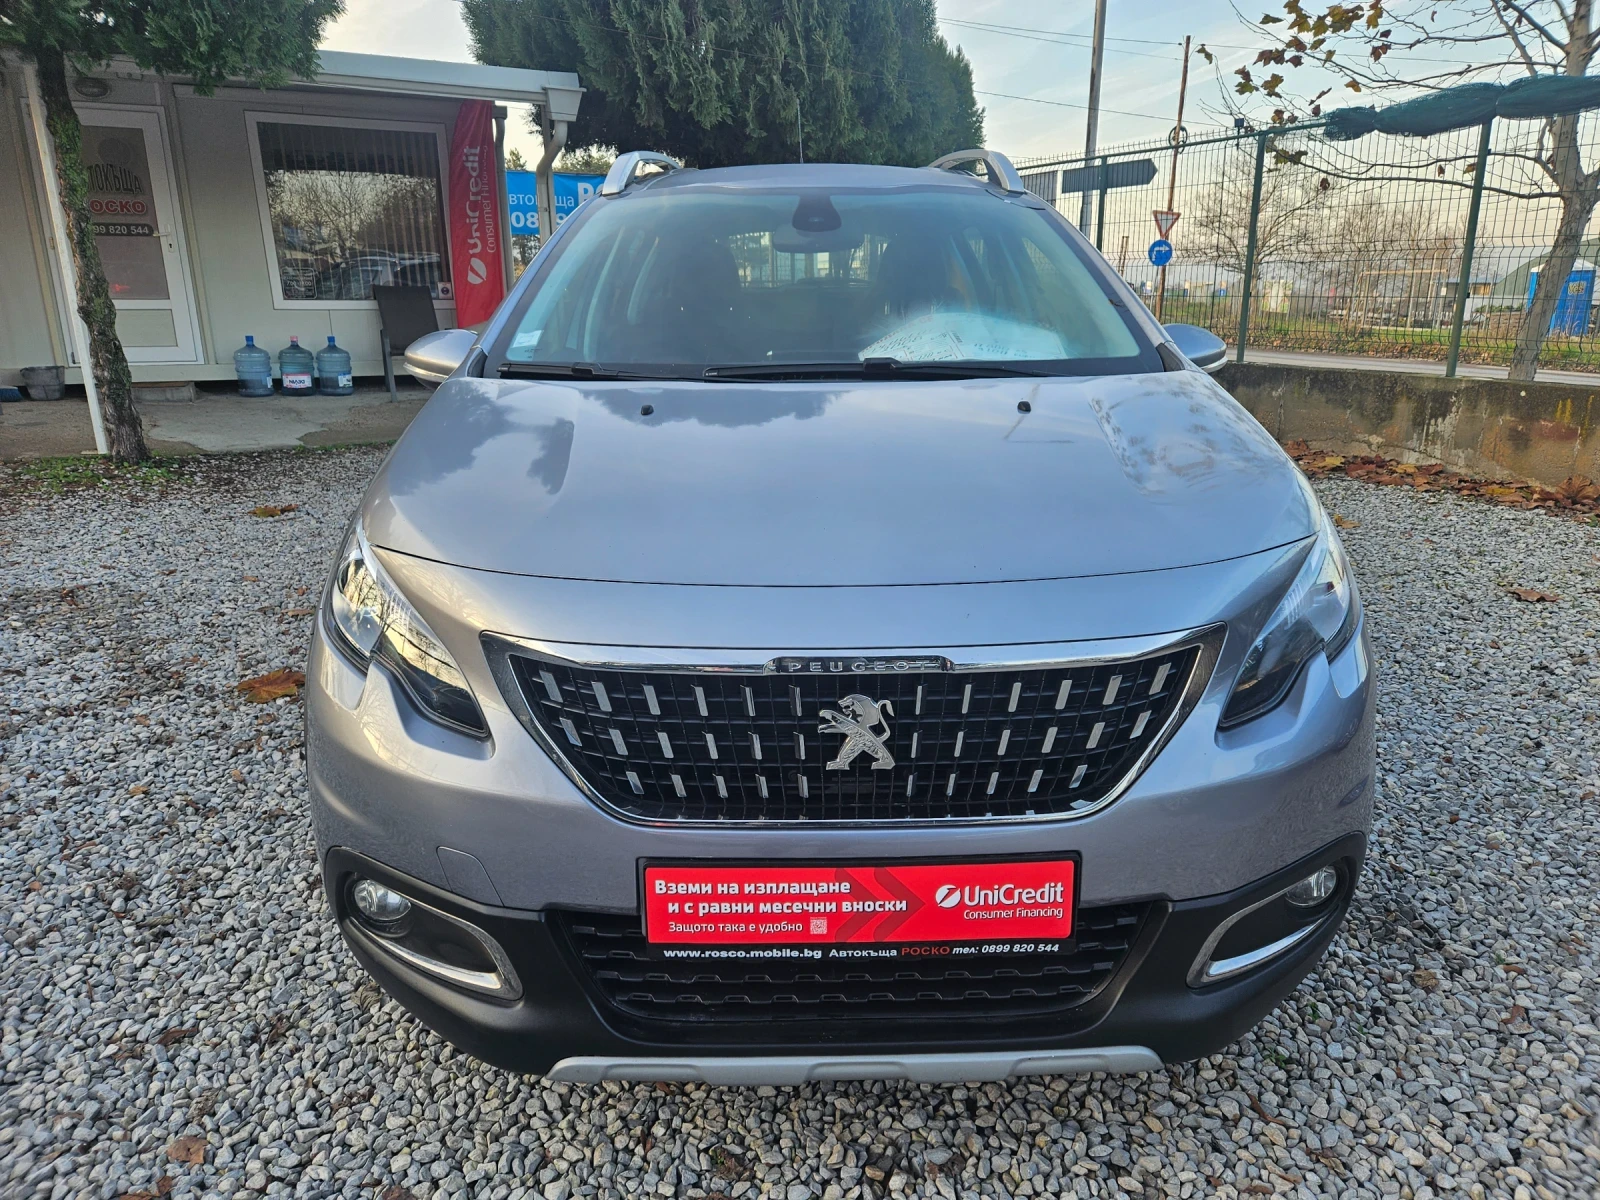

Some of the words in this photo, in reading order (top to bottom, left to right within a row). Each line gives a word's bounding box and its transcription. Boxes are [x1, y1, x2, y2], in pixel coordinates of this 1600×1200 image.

[87, 163, 143, 194] ТОКЪЩА
[90, 199, 146, 214] ОСКО
[463, 146, 482, 254] UniCredit
[509, 193, 575, 209] втоща
[93, 225, 106, 234] 99
[109, 225, 127, 234] 820
[130, 225, 149, 234] 544
[482, 200, 496, 253] Consumer
[788, 660, 932, 672] PEUGEOT
[655, 880, 712, 895] Вземи
[717, 883, 740, 895] на
[744, 881, 851, 897] изплащане
[964, 881, 1064, 906] UniCredit
[668, 902, 680, 914] и
[684, 902, 694, 914] с
[698, 902, 754, 917] равни
[759, 901, 837, 914] месечни
[842, 900, 907, 913] вноски
[963, 908, 1014, 920] Consumer
[1016, 906, 1063, 919] Financing
[668, 921, 715, 934] Защото
[718, 922, 746, 932] така
[749, 923, 756, 932] е
[759, 921, 803, 934] удобно
[663, 948, 822, 959] www.rosco.mobile.bg
[829, 948, 898, 958] Автокъща
[901, 946, 950, 956] РОСКО
[952, 945, 980, 954] тел:
[981, 944, 1010, 953] 0899
[1012, 943, 1034, 953] 820
[1037, 943, 1059, 952] 544
